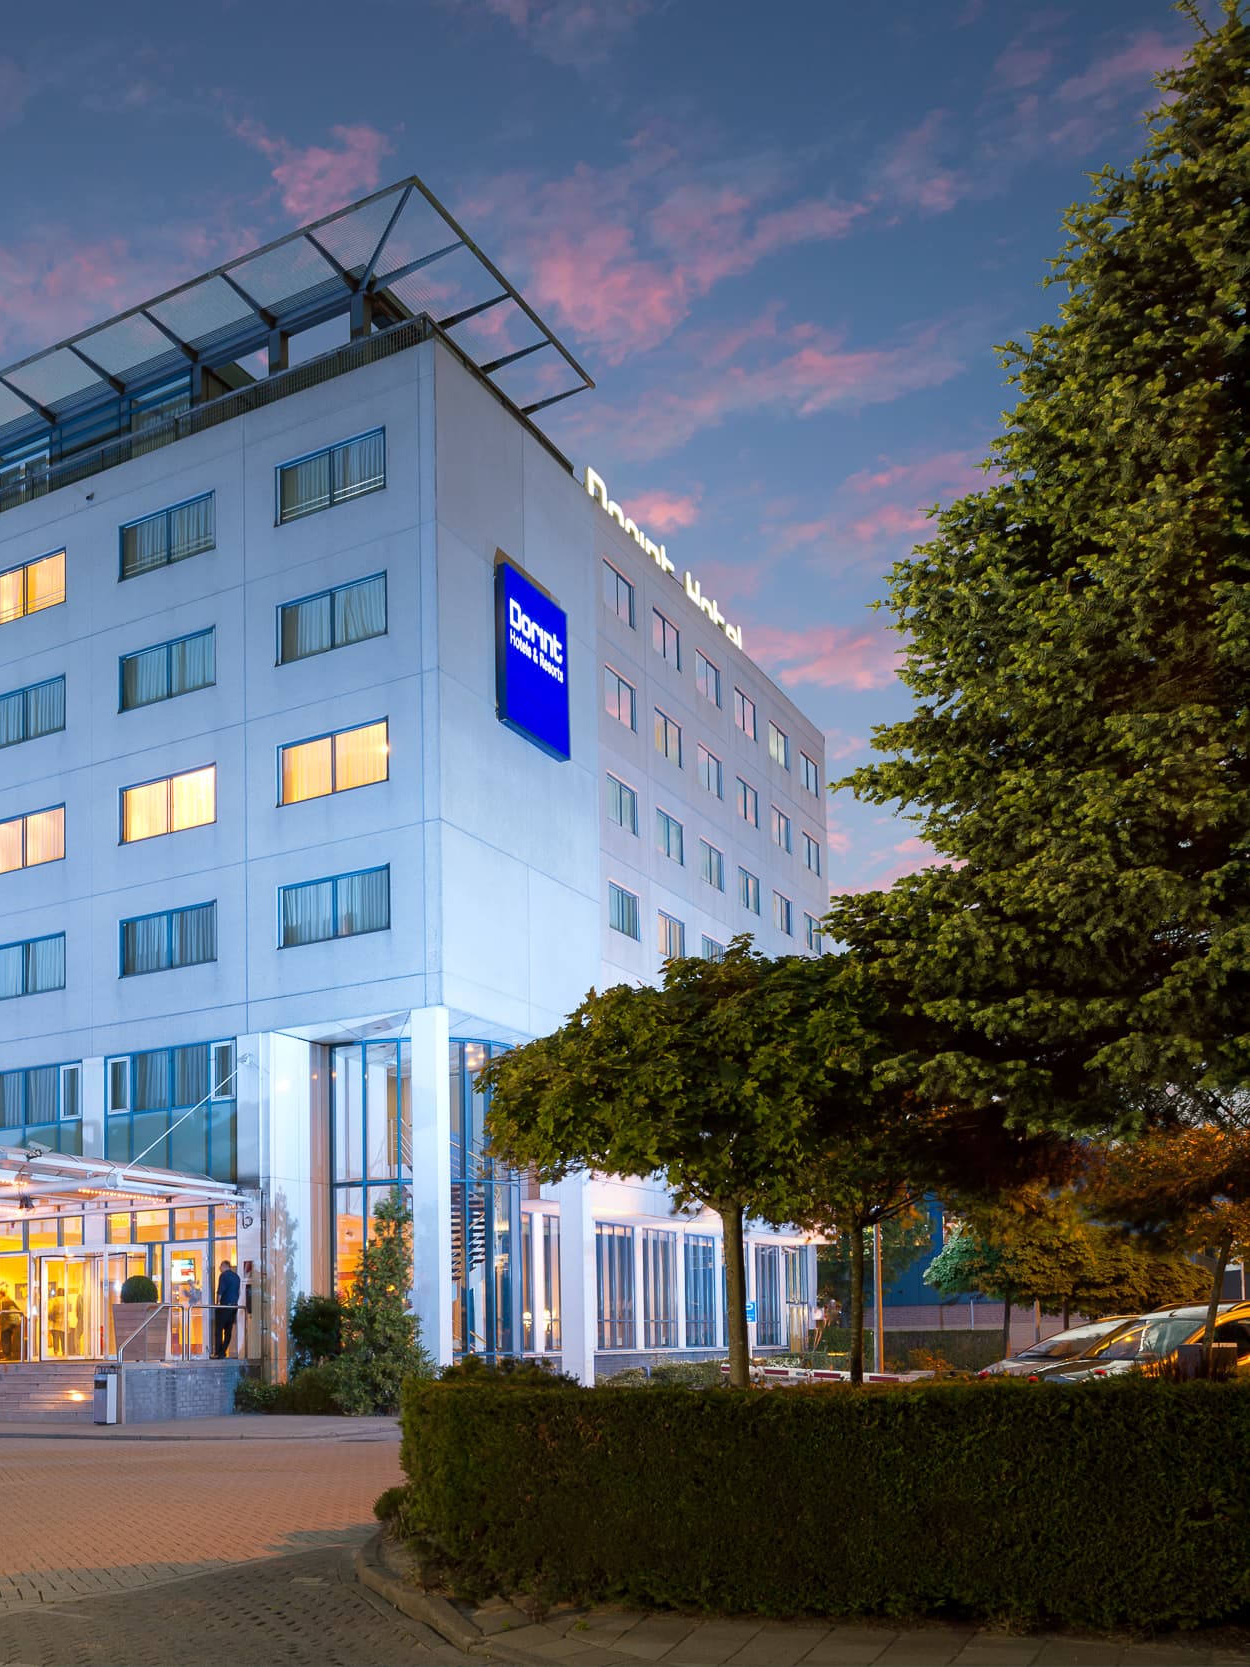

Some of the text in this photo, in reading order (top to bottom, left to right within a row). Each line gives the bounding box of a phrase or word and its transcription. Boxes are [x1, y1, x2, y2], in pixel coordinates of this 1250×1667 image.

[509, 597, 563, 664] Dorint
[509, 628, 564, 684] Hotels & Resorts
